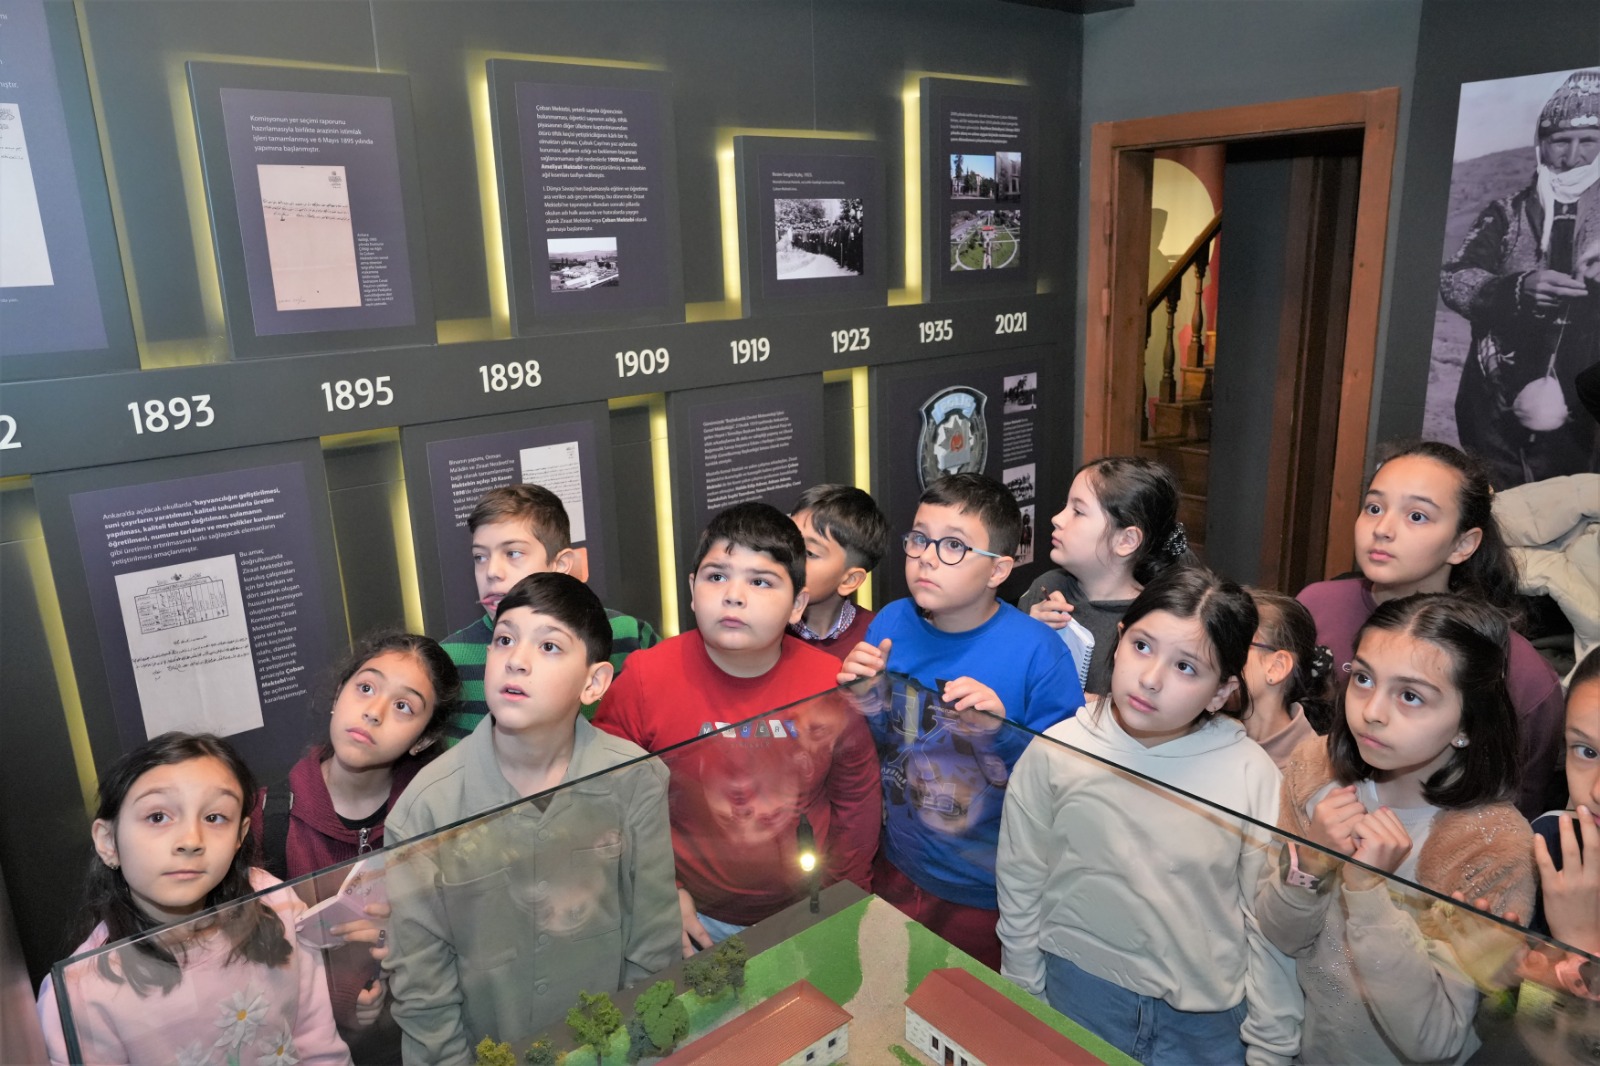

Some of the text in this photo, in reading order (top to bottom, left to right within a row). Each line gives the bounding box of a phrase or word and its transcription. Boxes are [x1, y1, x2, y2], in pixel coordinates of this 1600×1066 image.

[919, 319, 953, 344] 1935
[995, 311, 1028, 336] 2021
[730, 337, 771, 365] 1919
[831, 327, 870, 353] 1923
[479, 360, 542, 393] 1898
[615, 347, 670, 378] 1909
[320, 375, 394, 412] 1895
[127, 394, 215, 435] 1893
[102, 487, 280, 519] Ankara'da açılacak okullarda "hayvancılığın geliştirilmesi,
[104, 497, 274, 529] suni çayırların yaratılması, kaliteli tohumlarla üretim
[106, 508, 262, 539] yapılması, kaliteli tohum dağıtılması, sulamanın
[108, 535, 149, 547] öğretilmesi,
[150, 531, 178, 539] numune
[179, 527, 206, 535] tarlaları
[215, 518, 252, 528] meyvelikler
[109, 549, 122, 557] gibi
[123, 545, 151, 553] üretimin
[152, 538, 191, 549] artırılmasına
[208, 529, 240, 539] sağlayacak
[241, 523, 275, 533] elemanların
[111, 546, 198, 566] yetiştirilmesi amaçlanmıştır.
